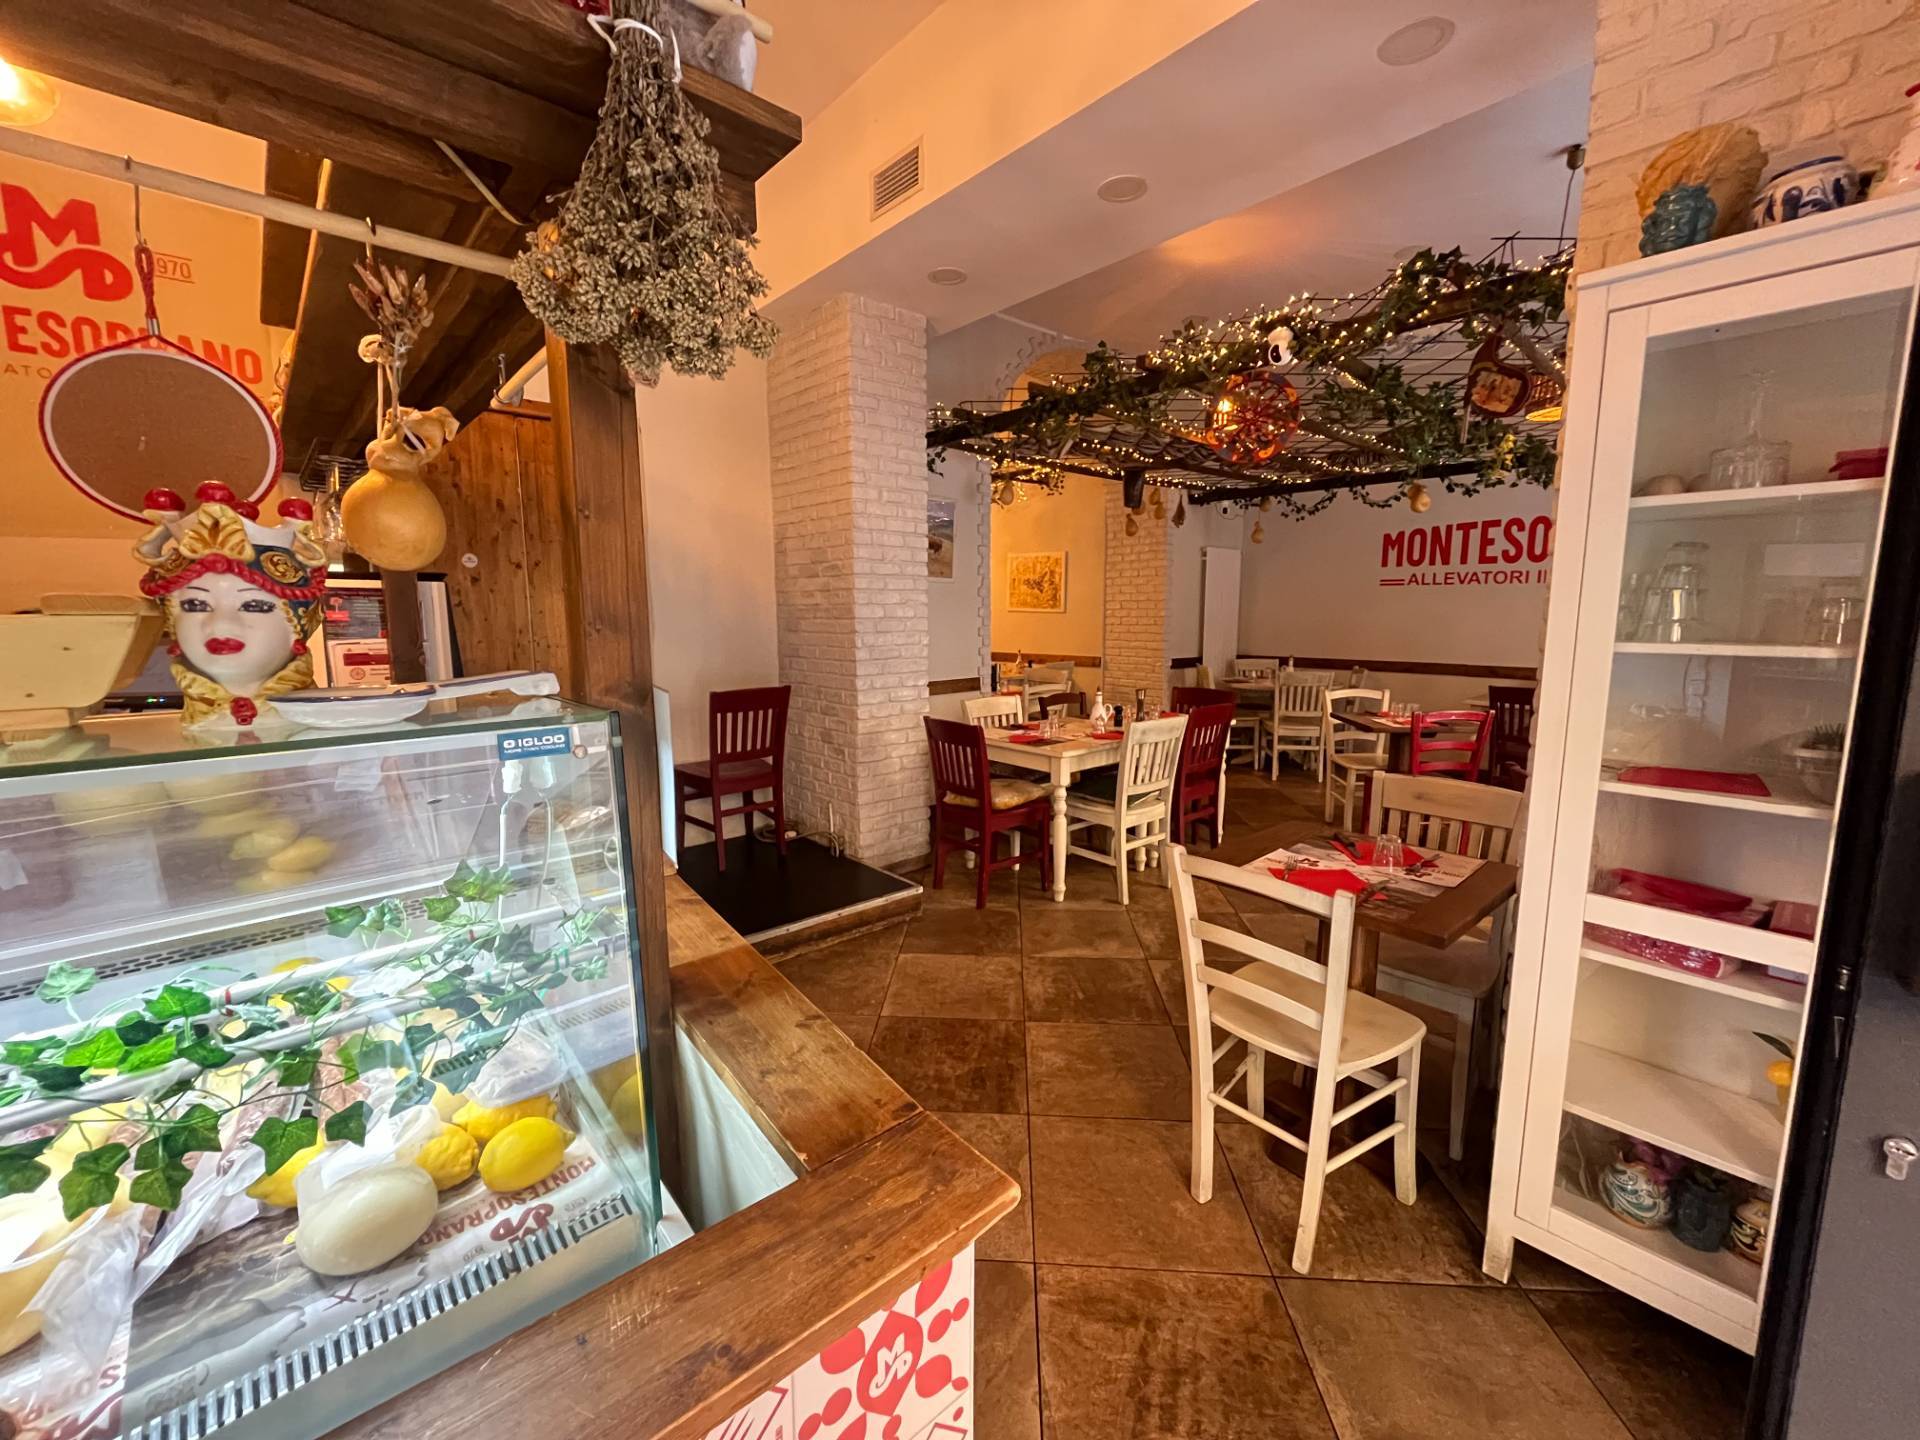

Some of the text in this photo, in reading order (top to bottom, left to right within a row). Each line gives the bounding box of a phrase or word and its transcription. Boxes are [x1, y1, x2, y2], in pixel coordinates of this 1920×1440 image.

[155, 257, 192, 279] 970
[1381, 515, 1553, 568] MONTESO
[1407, 570, 1530, 586] ALLEVATORI
[518, 734, 566, 747] IGLOO
